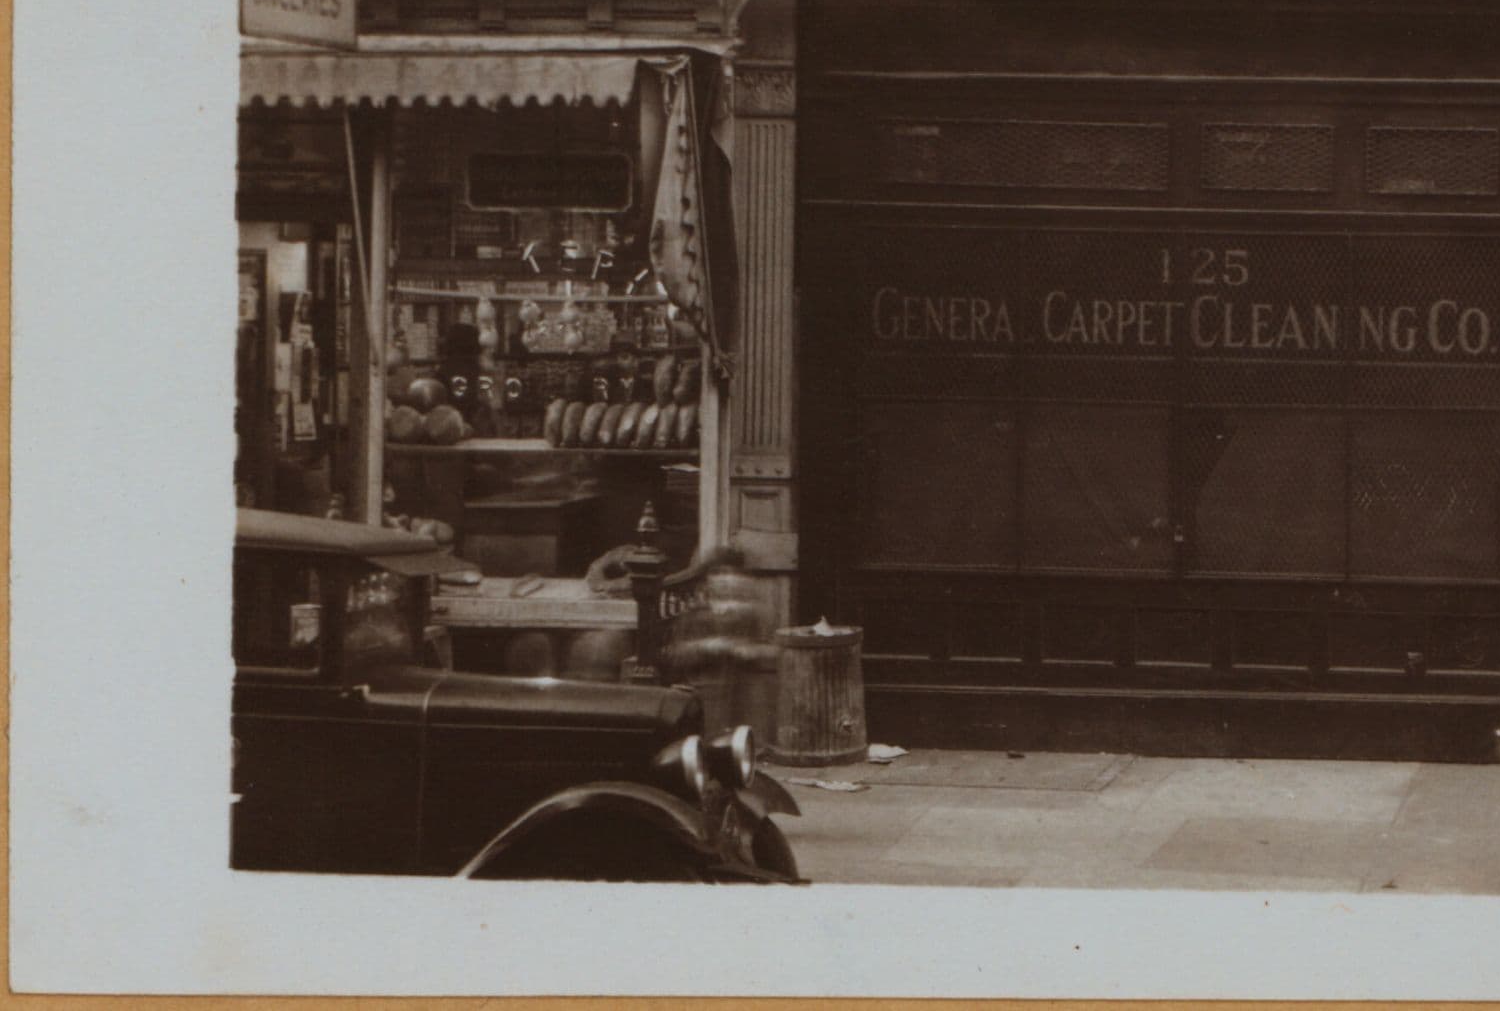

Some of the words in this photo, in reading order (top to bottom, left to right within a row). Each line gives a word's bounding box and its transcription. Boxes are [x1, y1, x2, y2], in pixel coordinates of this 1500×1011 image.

[1162, 248, 1250, 286] 125
[871, 286, 1032, 343] GENERA
[1042, 290, 1186, 346] CARPET
[1190, 295, 1417, 353] CLEANNG
[451, 375, 635, 401] GRORY
